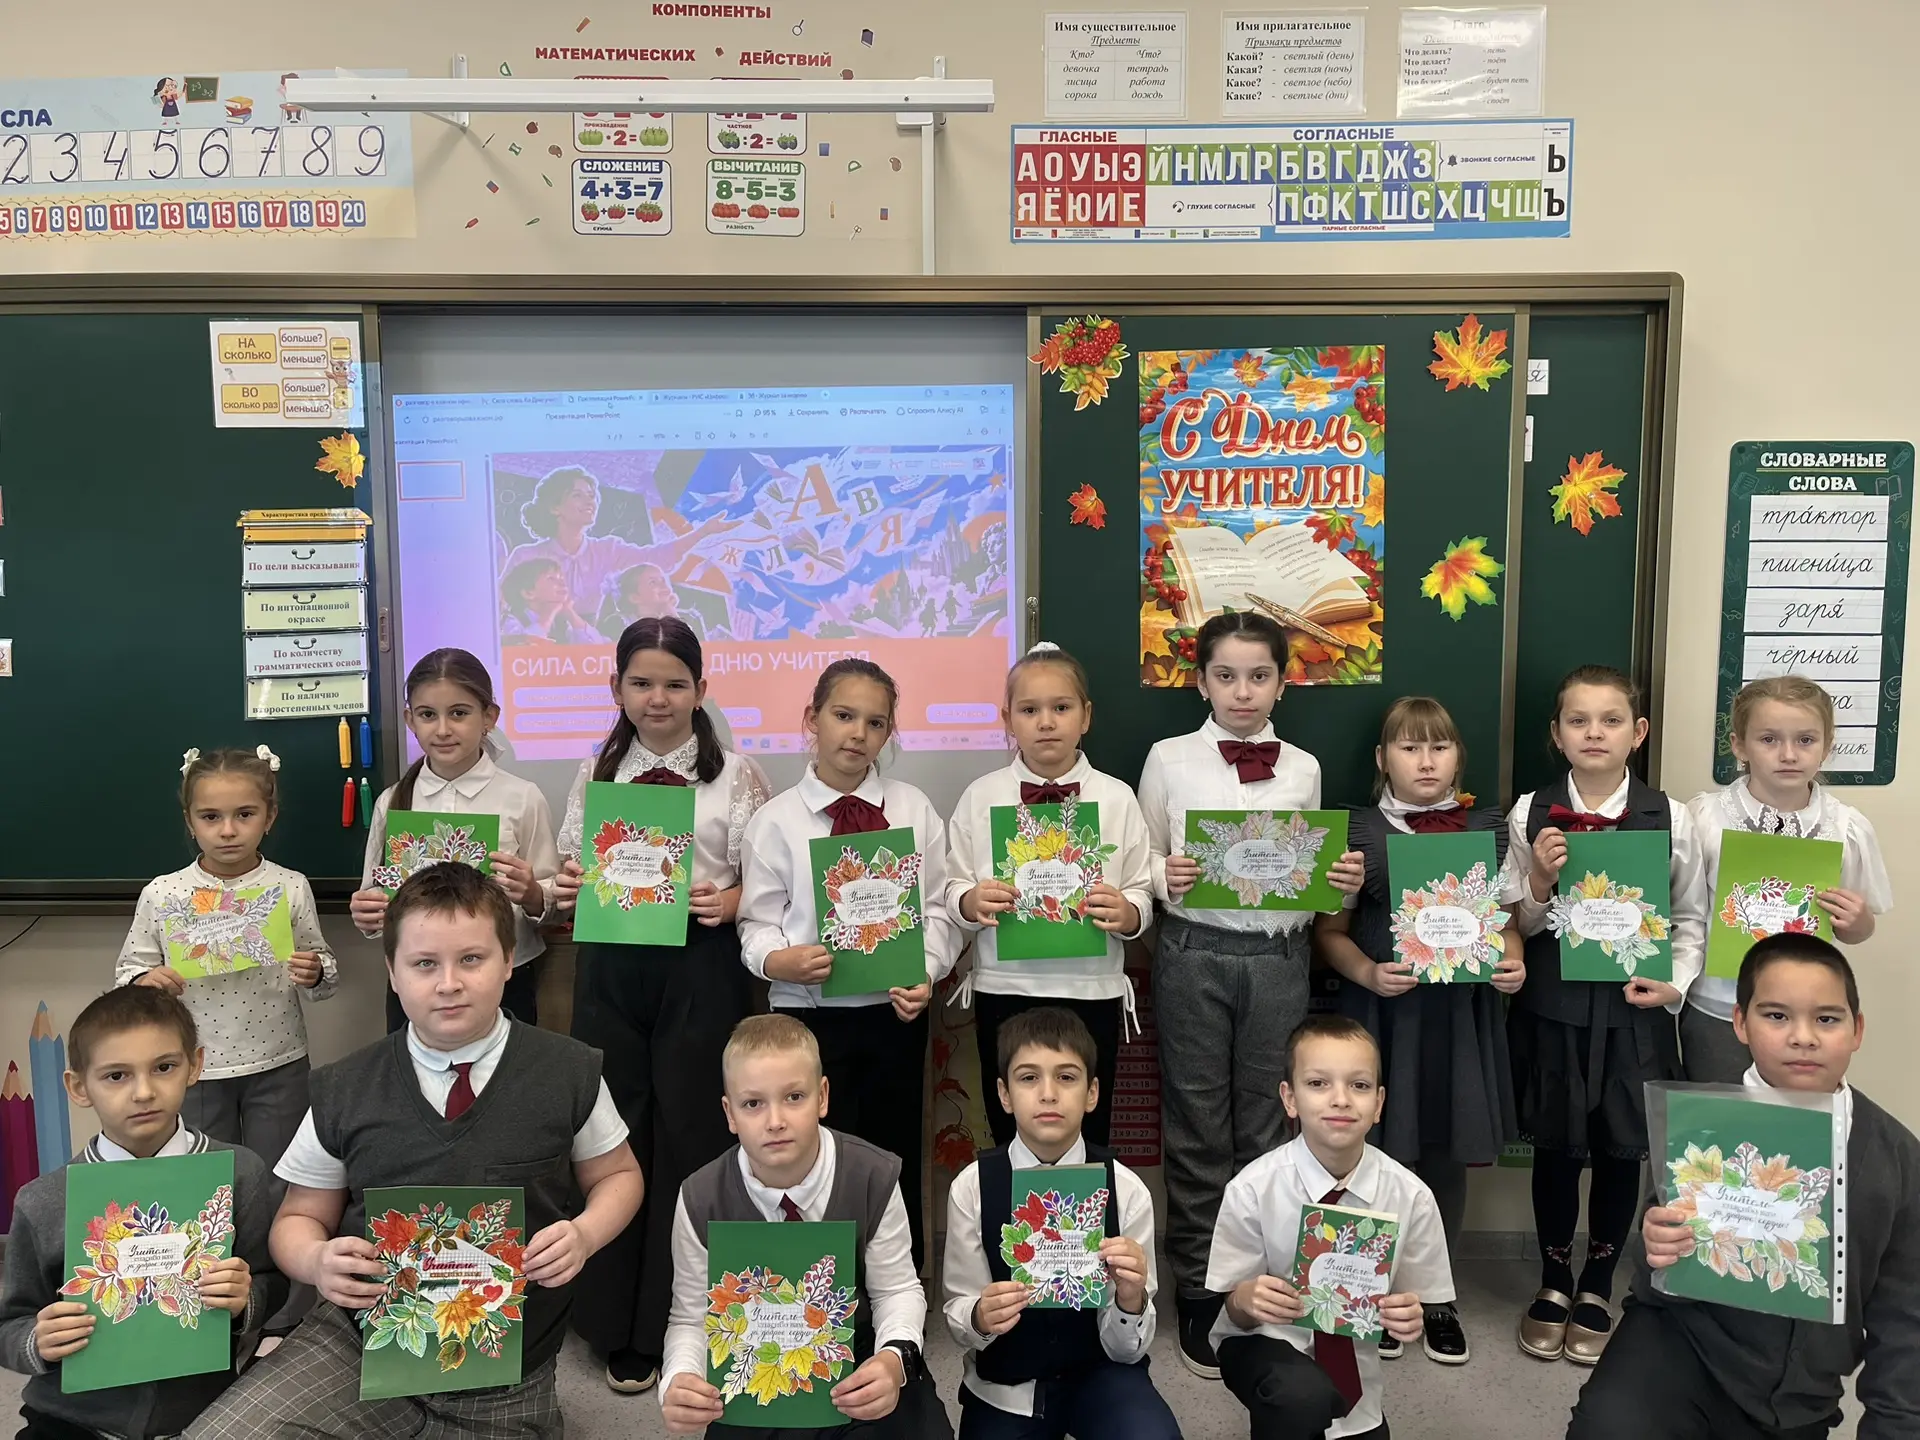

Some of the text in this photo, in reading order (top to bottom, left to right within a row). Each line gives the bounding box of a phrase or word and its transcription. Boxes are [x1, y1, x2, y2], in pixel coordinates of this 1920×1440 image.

[652, 4, 771, 19] КОМПОНЕНТЫ
[1054, 22, 1176, 33] Имя существительное
[1236, 21, 1351, 32] Имя прилагательное
[1091, 35, 1141, 46] Предметы
[1245, 37, 1342, 49] Признаки предметов
[535, 47, 832, 67] МАТЕМАТИЧЕСКИХ ДЕЙСТВИЙ
[1070, 50, 1161, 59] Кто? Что?
[1227, 51, 1354, 61] Какой? светлый (день)
[1063, 64, 1169, 75] девочка тетрадь
[1226, 64, 1352, 74] Какая? светлая (ночь)
[1065, 77, 1165, 88] лисица работа
[1226, 77, 1352, 87] Какое? светлое (небо)
[1065, 90, 1163, 101] сорока дождь
[1226, 90, 1349, 100] Какие? светлые (дни)
[1, 109, 53, 128] СЛА
[1039, 131, 1117, 142] ГЛАСНЫЕ
[1293, 128, 1394, 140] СОГЛАСНЫЕ
[2, 125, 385, 184] 2 3 4 5 6 7 8 9
[583, 161, 660, 172] СЛОЖЕНИЕ
[713, 161, 799, 173] ВЫЧИТАНИЕ
[17, 211, 27, 229] 6
[34, 210, 46, 228] 7
[52, 209, 62, 228] 8
[69, 208, 80, 227] 9
[87, 207, 105, 227] 10
[113, 206, 129, 226] 11
[137, 206, 156, 226] 12
[163, 205, 181, 225] 13
[188, 204, 207, 224] 14
[215, 204, 233, 224] 15
[239, 204, 259, 223] 16
[266, 204, 284, 223] 17
[291, 203, 311, 223] 18
[317, 203, 337, 222] 19
[343, 203, 363, 222] 20
[238, 338, 256, 348] НА
[281, 334, 322, 343] больше?
[283, 355, 326, 363] меньше?
[242, 387, 258, 397] ВО
[284, 384, 325, 393] больше?
[224, 401, 278, 411] сколько раз
[286, 404, 329, 413] меньше?
[1161, 397, 1205, 460] С
[1760, 452, 1887, 468] СЛОВАРНЫЕ
[1161, 464, 1364, 512] УЧИТЕЛЯ!
[1789, 477, 1857, 491] СЛОВА
[248, 562, 360, 572] По цели высказывания
[261, 601, 350, 611] По интонационной
[288, 616, 326, 625] окраске
[273, 648, 343, 658] По количеству
[512, 657, 576, 676] СИЛА
[709, 652, 763, 674] ДНЮ
[1767, 645, 1859, 674] чёрный
[254, 659, 361, 672] грамматических основ
[282, 691, 339, 701] По наличию
[333, 702, 364, 710] членов
